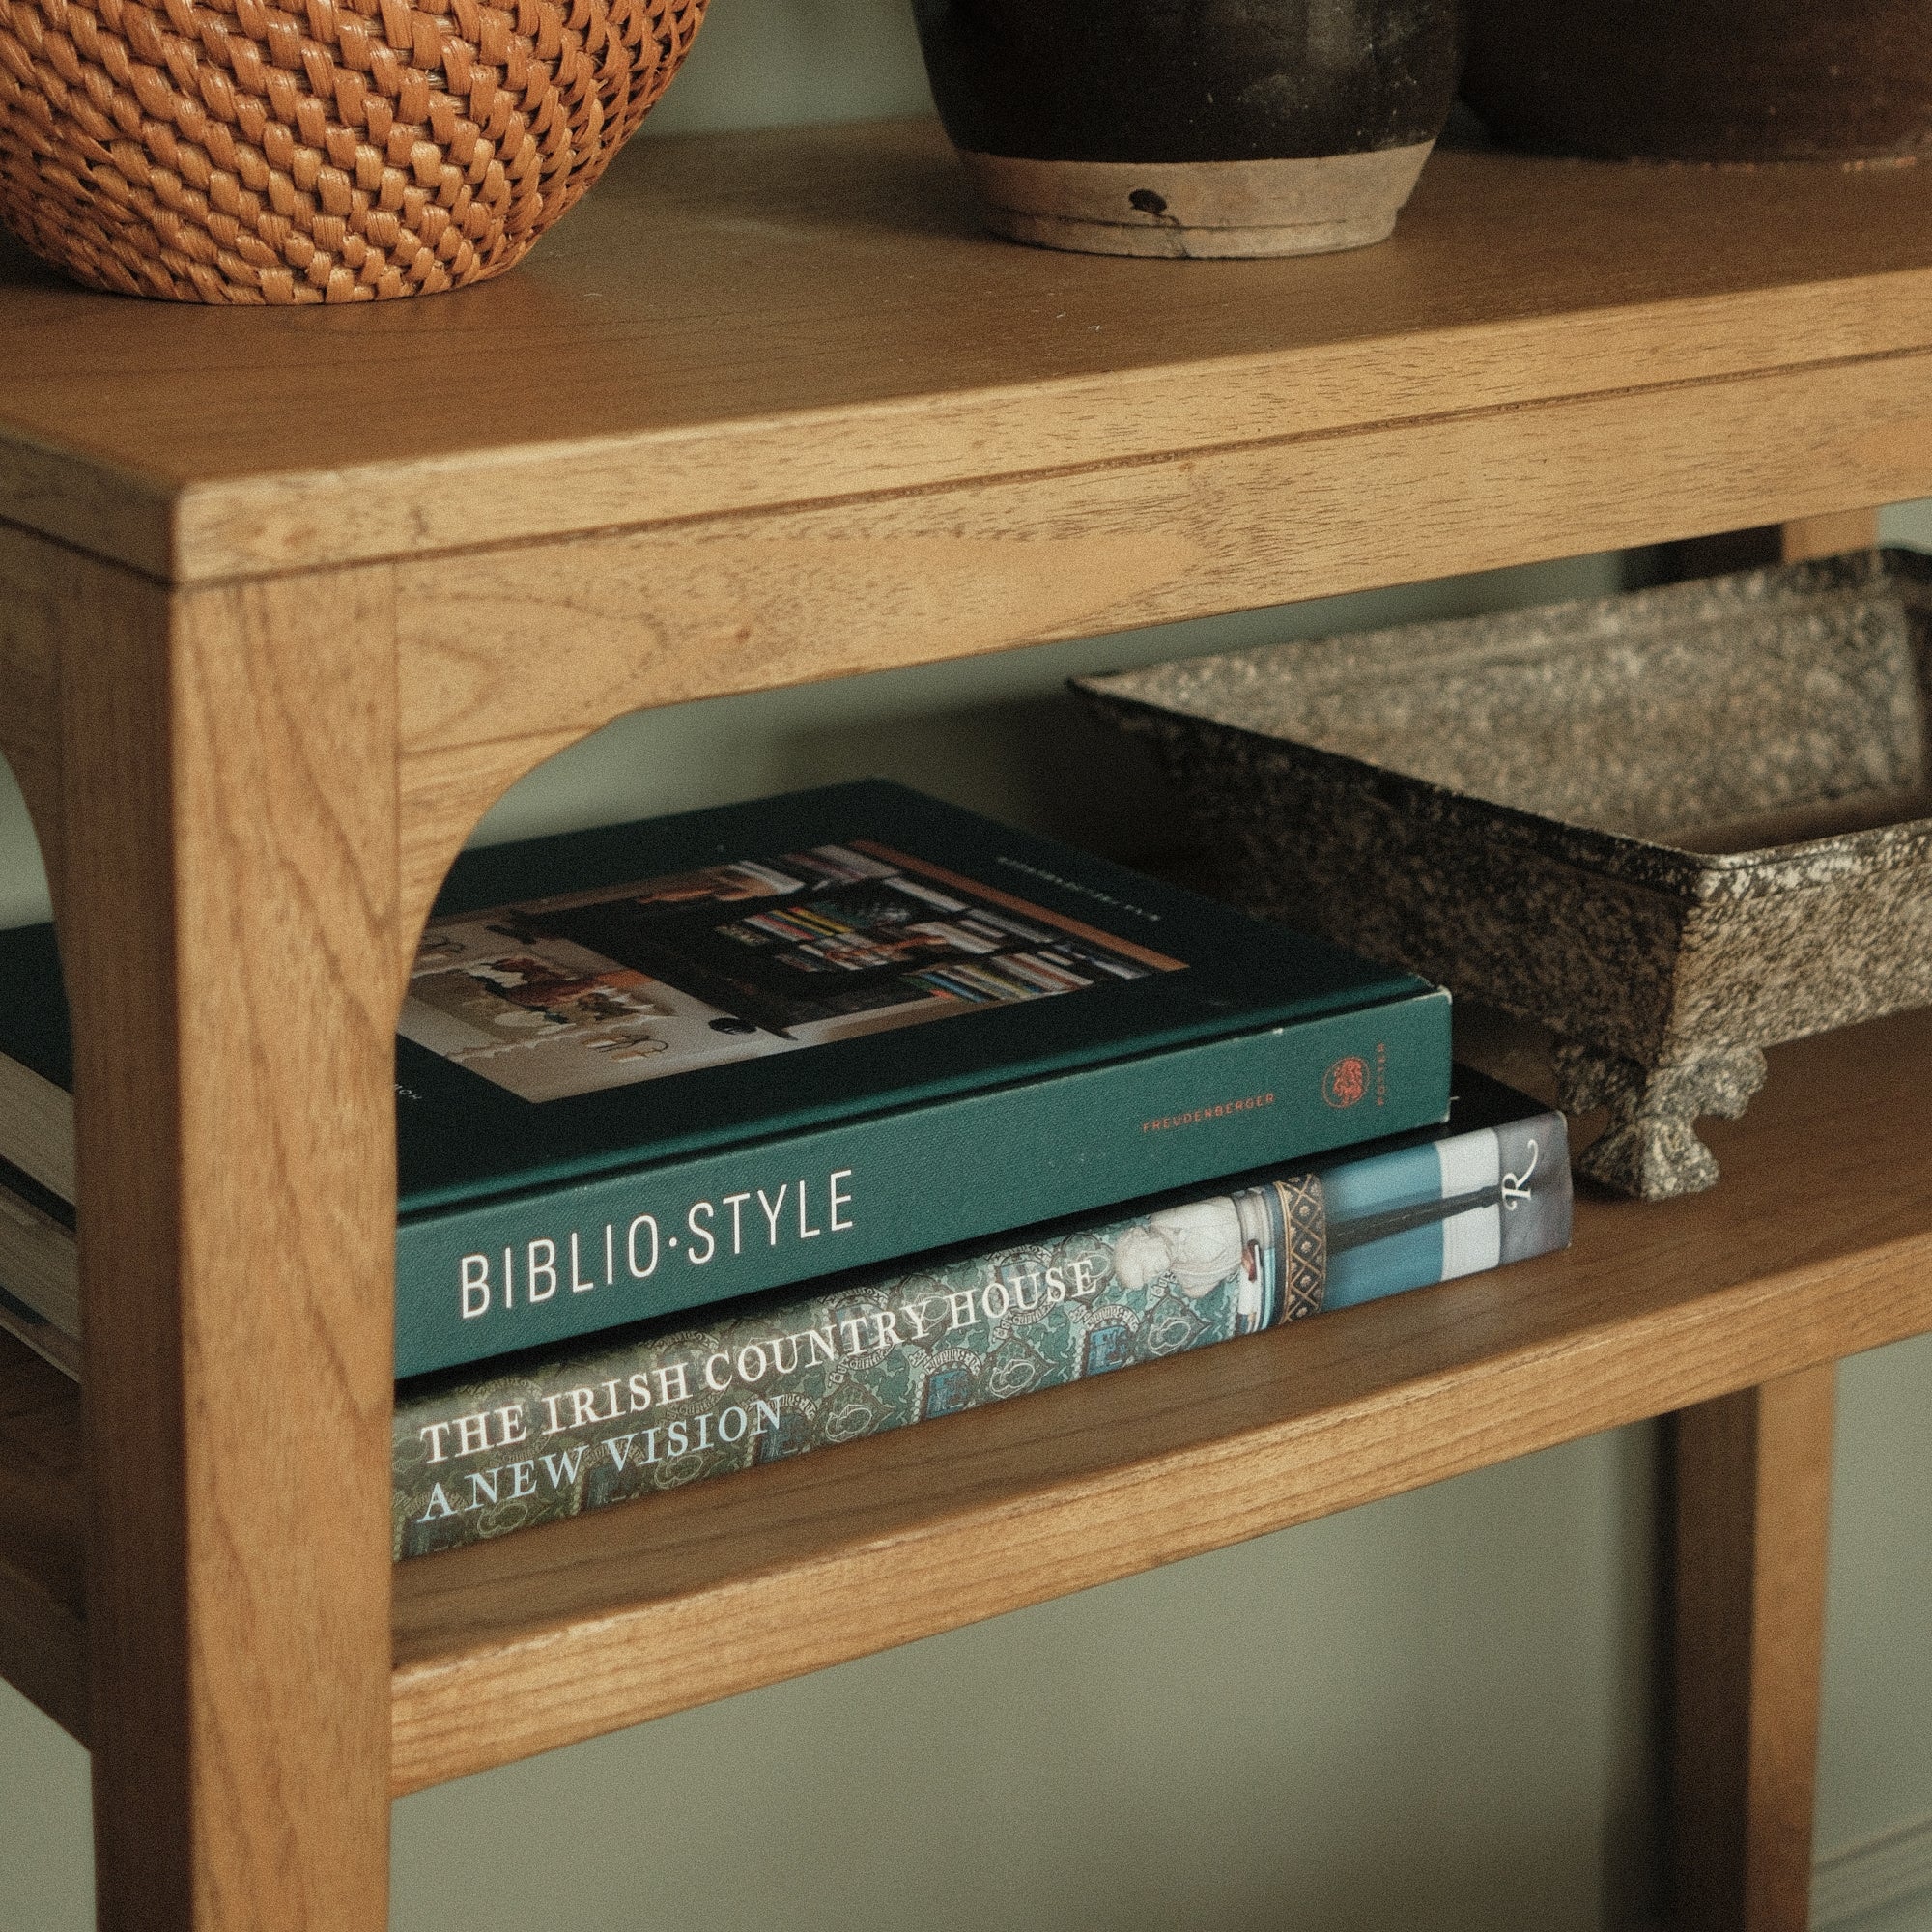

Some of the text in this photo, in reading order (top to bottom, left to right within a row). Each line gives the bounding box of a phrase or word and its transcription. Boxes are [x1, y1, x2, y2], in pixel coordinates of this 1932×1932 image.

[1142, 1092, 1276, 1133] FREUDENBERGER
[419, 1407, 528, 1464] THE
[541, 1363, 694, 1437] IRISH
[705, 1300, 929, 1391] COUNTRY
[946, 1259, 1099, 1330] HOUSE
[416, 1395, 785, 1523] A NEW VISION
